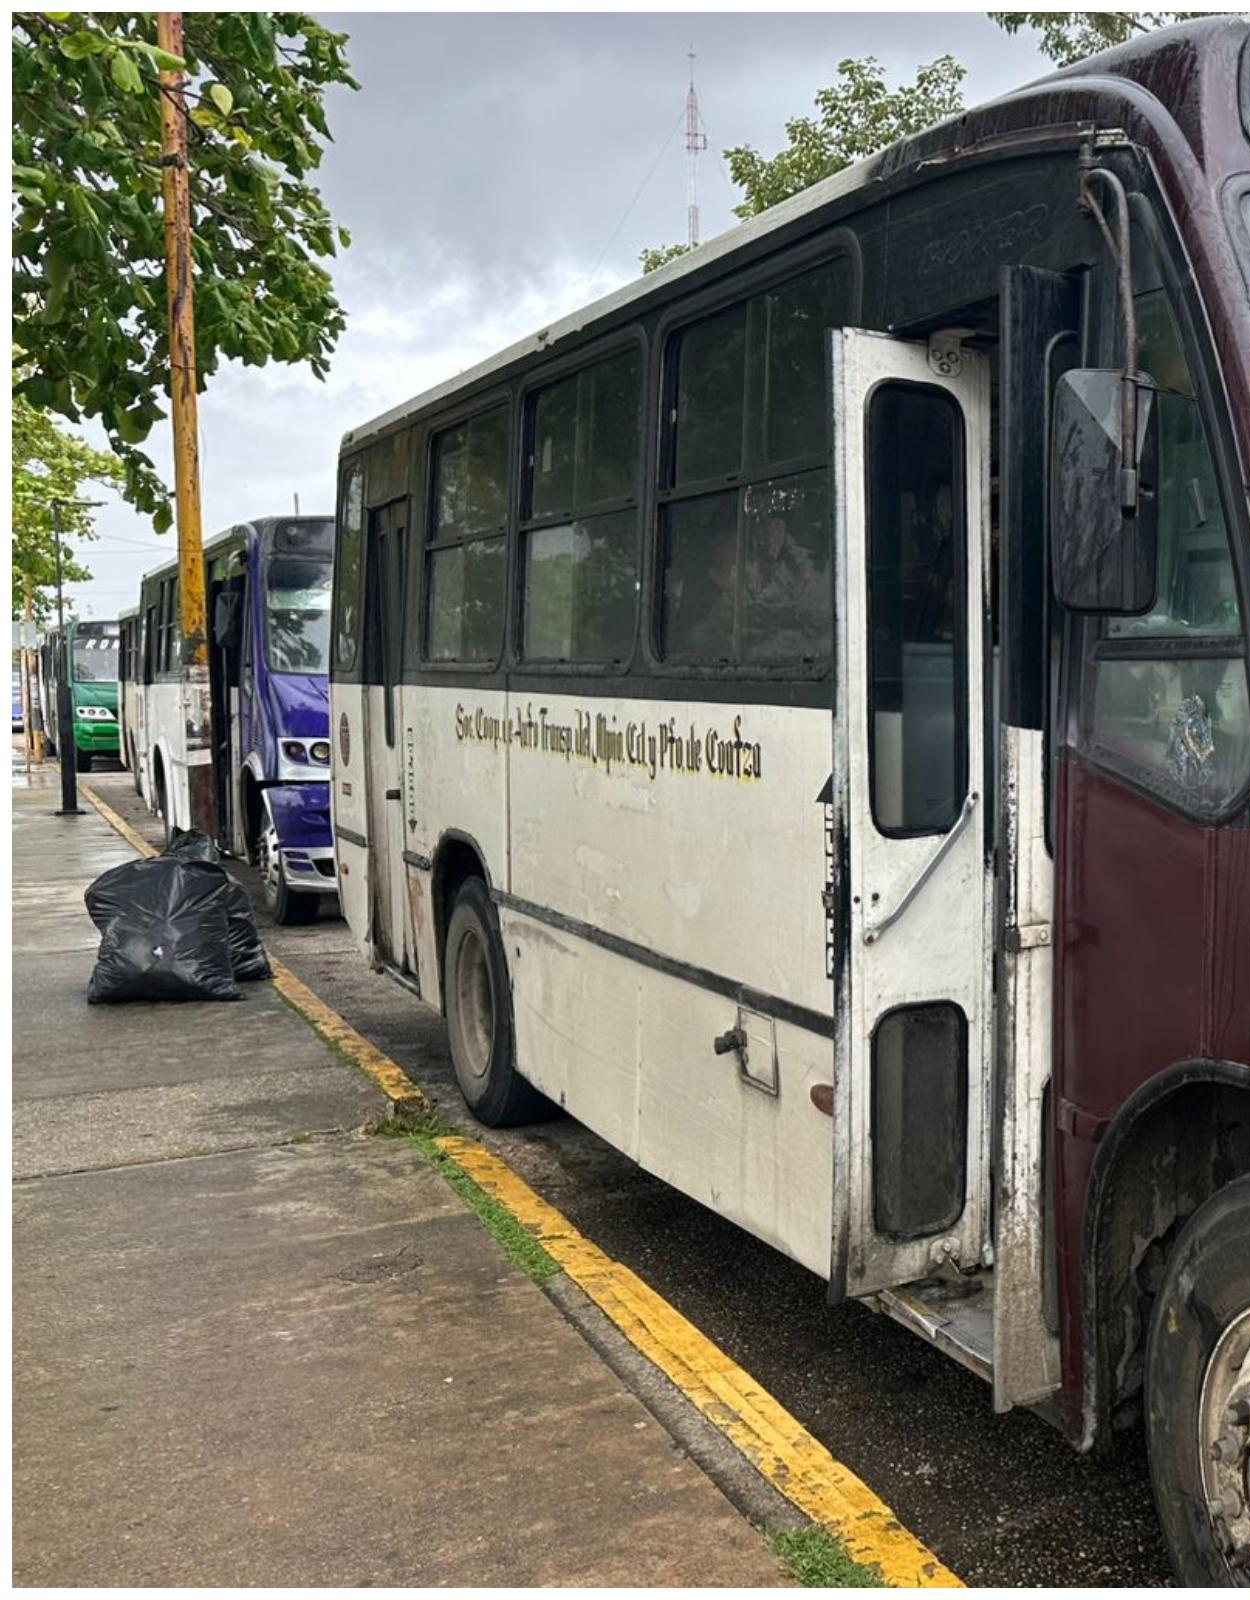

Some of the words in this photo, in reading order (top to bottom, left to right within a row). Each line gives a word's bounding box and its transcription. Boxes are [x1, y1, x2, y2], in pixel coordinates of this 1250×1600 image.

[648, 735, 657, 780] y
[686, 721, 702, 772] de
[705, 714, 762, 779] Coatza
